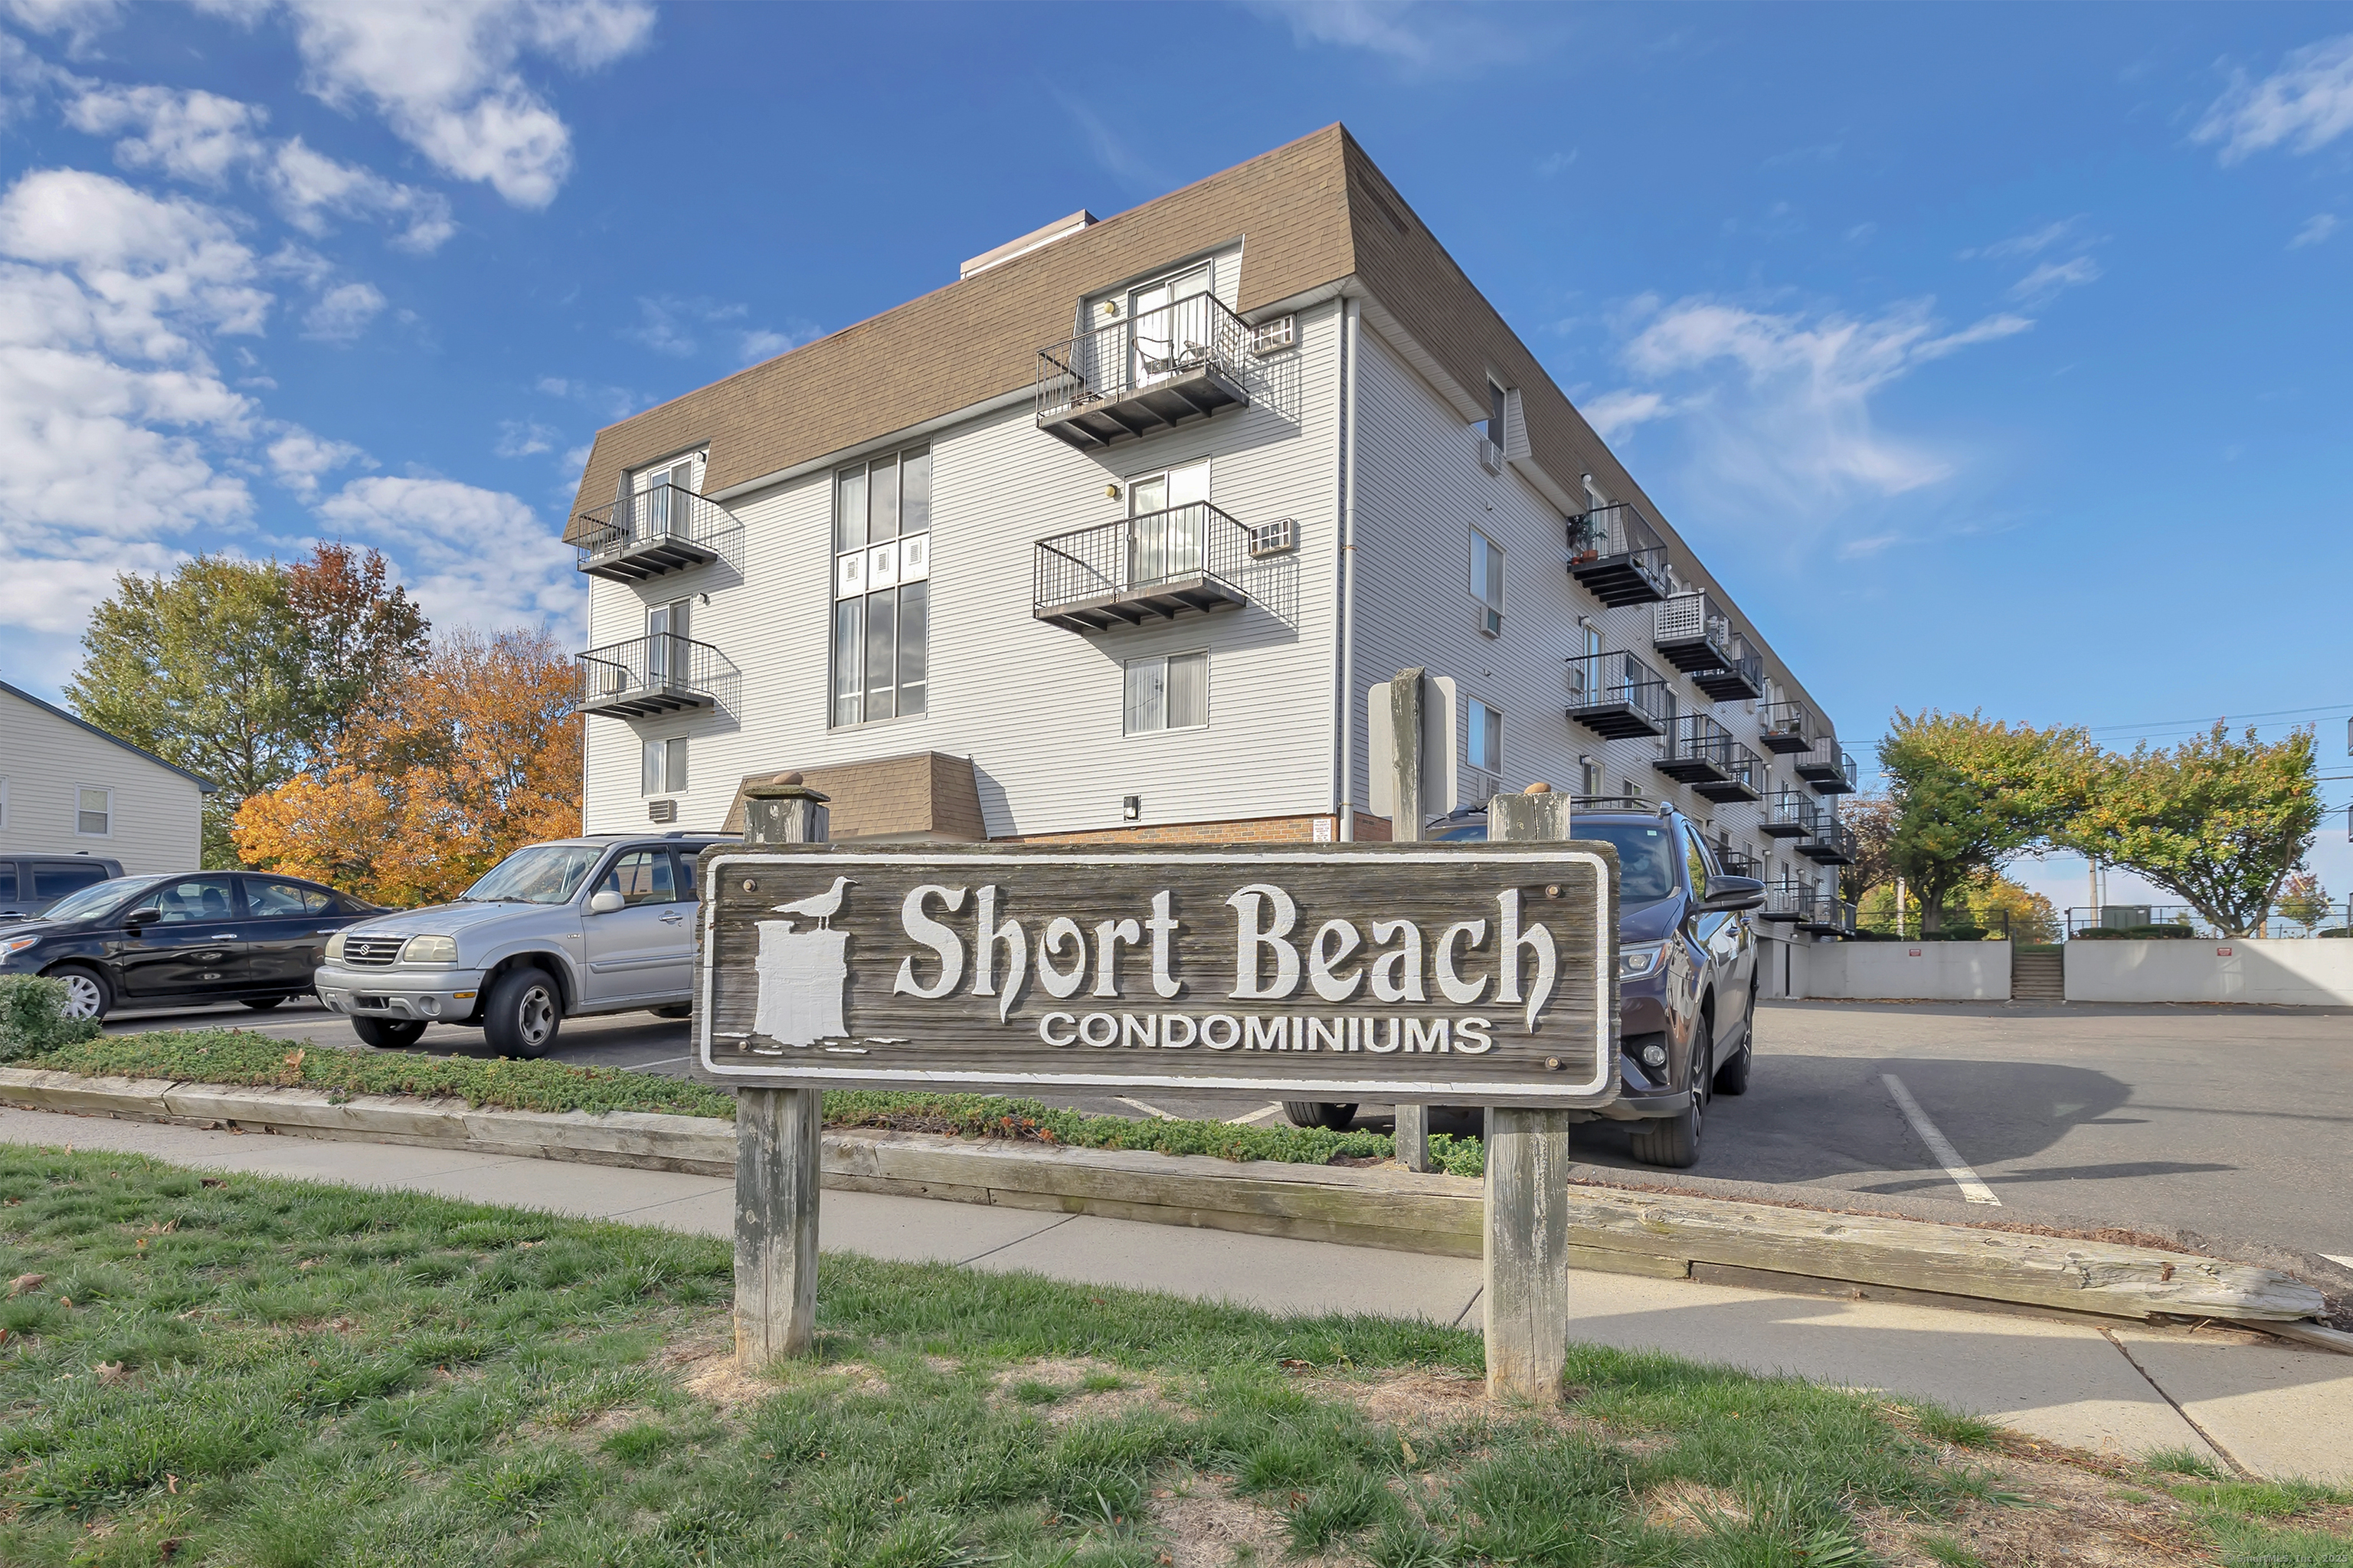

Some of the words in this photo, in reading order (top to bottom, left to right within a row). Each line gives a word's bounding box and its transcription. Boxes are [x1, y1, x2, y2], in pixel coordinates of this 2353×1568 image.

[894, 885, 1182, 1026] Short
[1226, 883, 1556, 1034] Beach
[1039, 1012, 1493, 1055] CONDOMINIUMS
